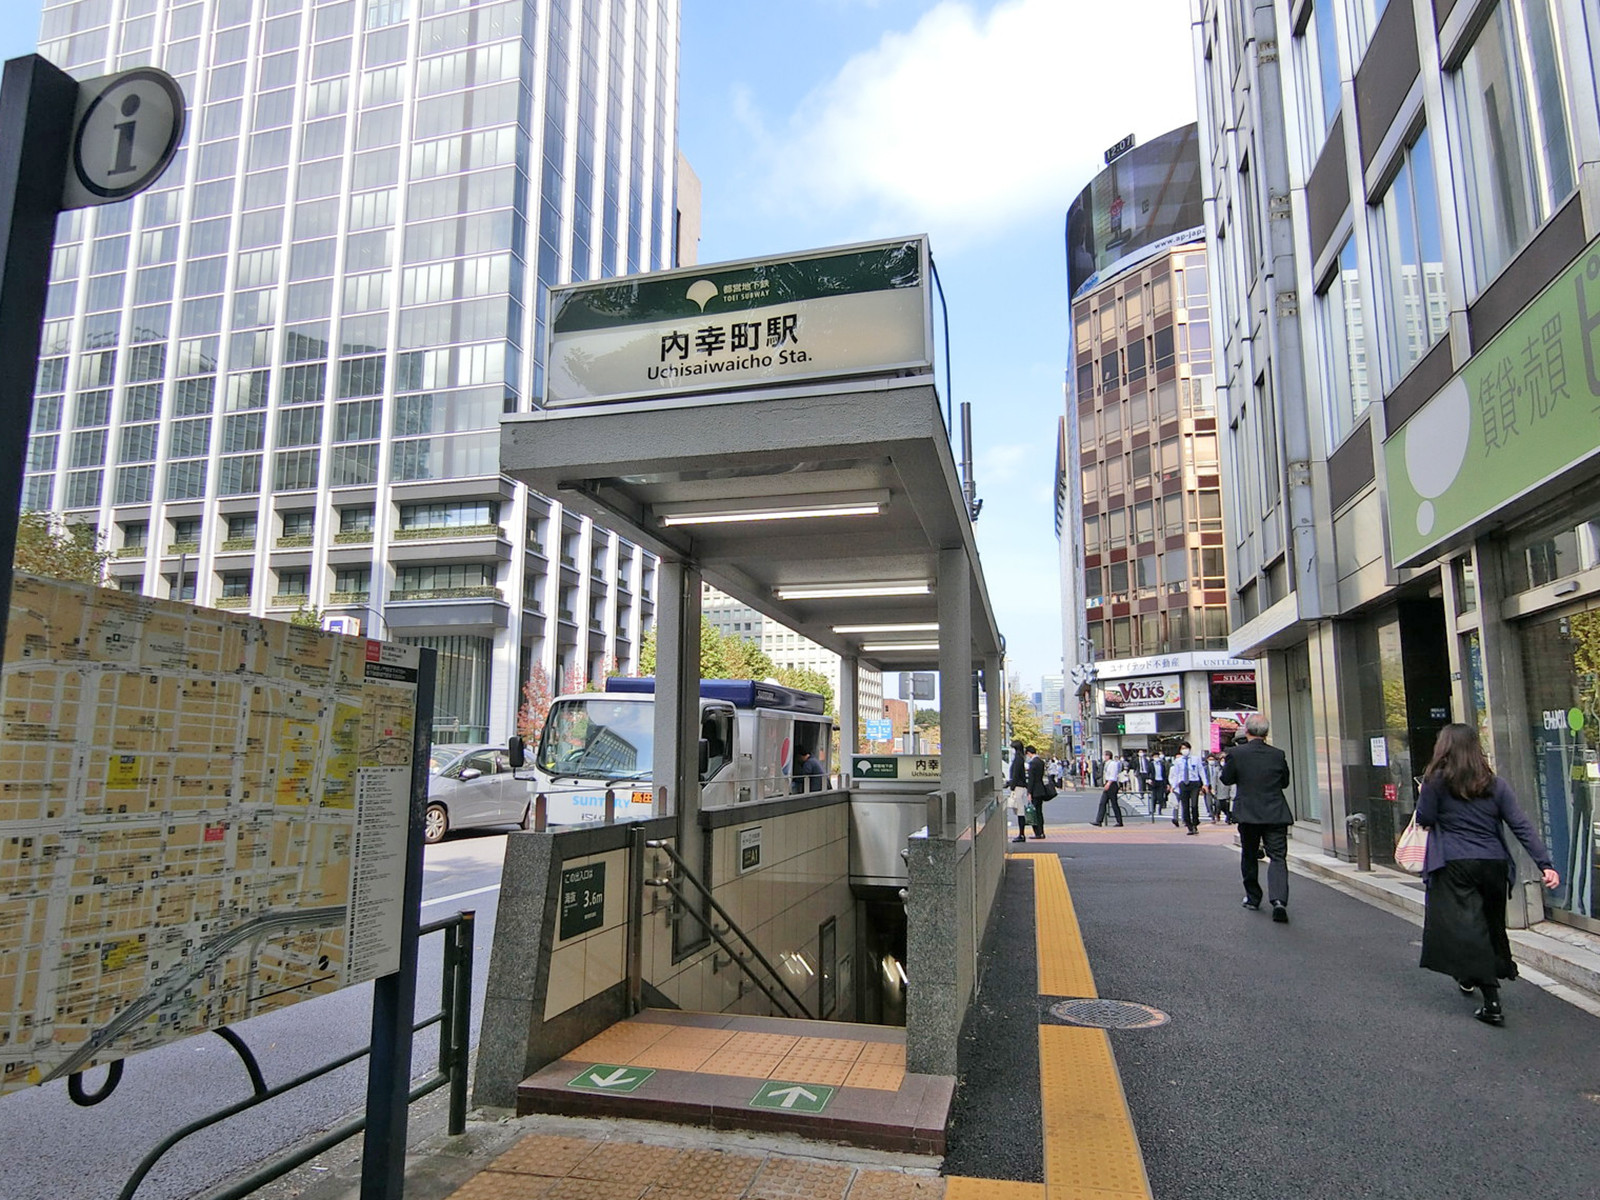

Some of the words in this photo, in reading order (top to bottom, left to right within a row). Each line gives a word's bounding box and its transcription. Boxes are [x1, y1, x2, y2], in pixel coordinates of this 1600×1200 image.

[1107, 136, 1131, 159] 12:07
[723, 279, 770, 294] 都営地下鉄
[723, 295, 739, 303] TOEI
[741, 289, 770, 301] SUBWAY
[660, 313, 799, 363] 内幸町駅
[647, 353, 773, 381] Uchisaiwaicho
[779, 348, 813, 367] Sta.
[1203, 658, 1239, 667] UNITED
[1223, 674, 1252, 682] STEAK
[1118, 681, 1165, 702] VOLKS
[572, 794, 630, 809] SUNTRY
[583, 890, 603, 908] 3.6m
